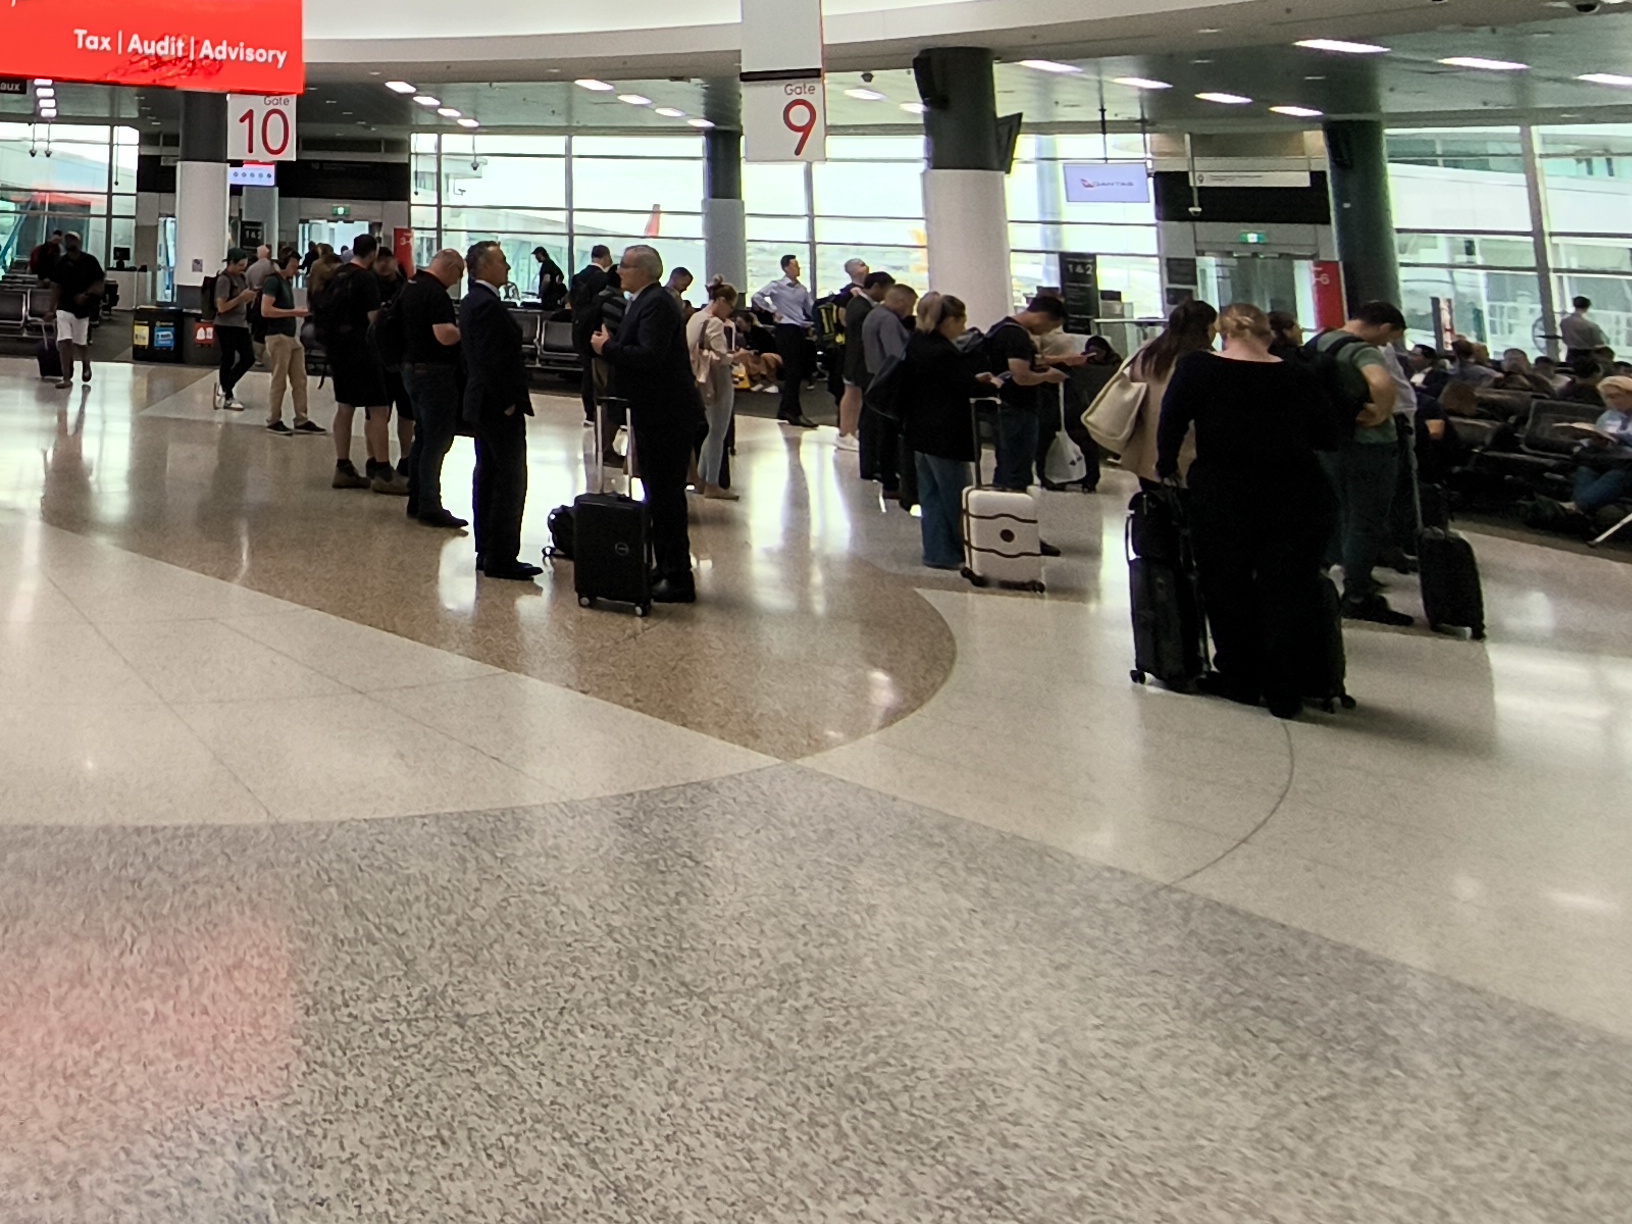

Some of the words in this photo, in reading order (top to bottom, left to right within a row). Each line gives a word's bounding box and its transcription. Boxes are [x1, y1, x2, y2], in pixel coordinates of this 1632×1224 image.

[73, 28, 112, 51] Tax
[127, 33, 185, 58] Audit
[199, 39, 288, 70] Advisory
[263, 96, 291, 107] Gate
[784, 82, 816, 96] Gate
[238, 108, 290, 156] 10
[782, 98, 817, 156] 9
